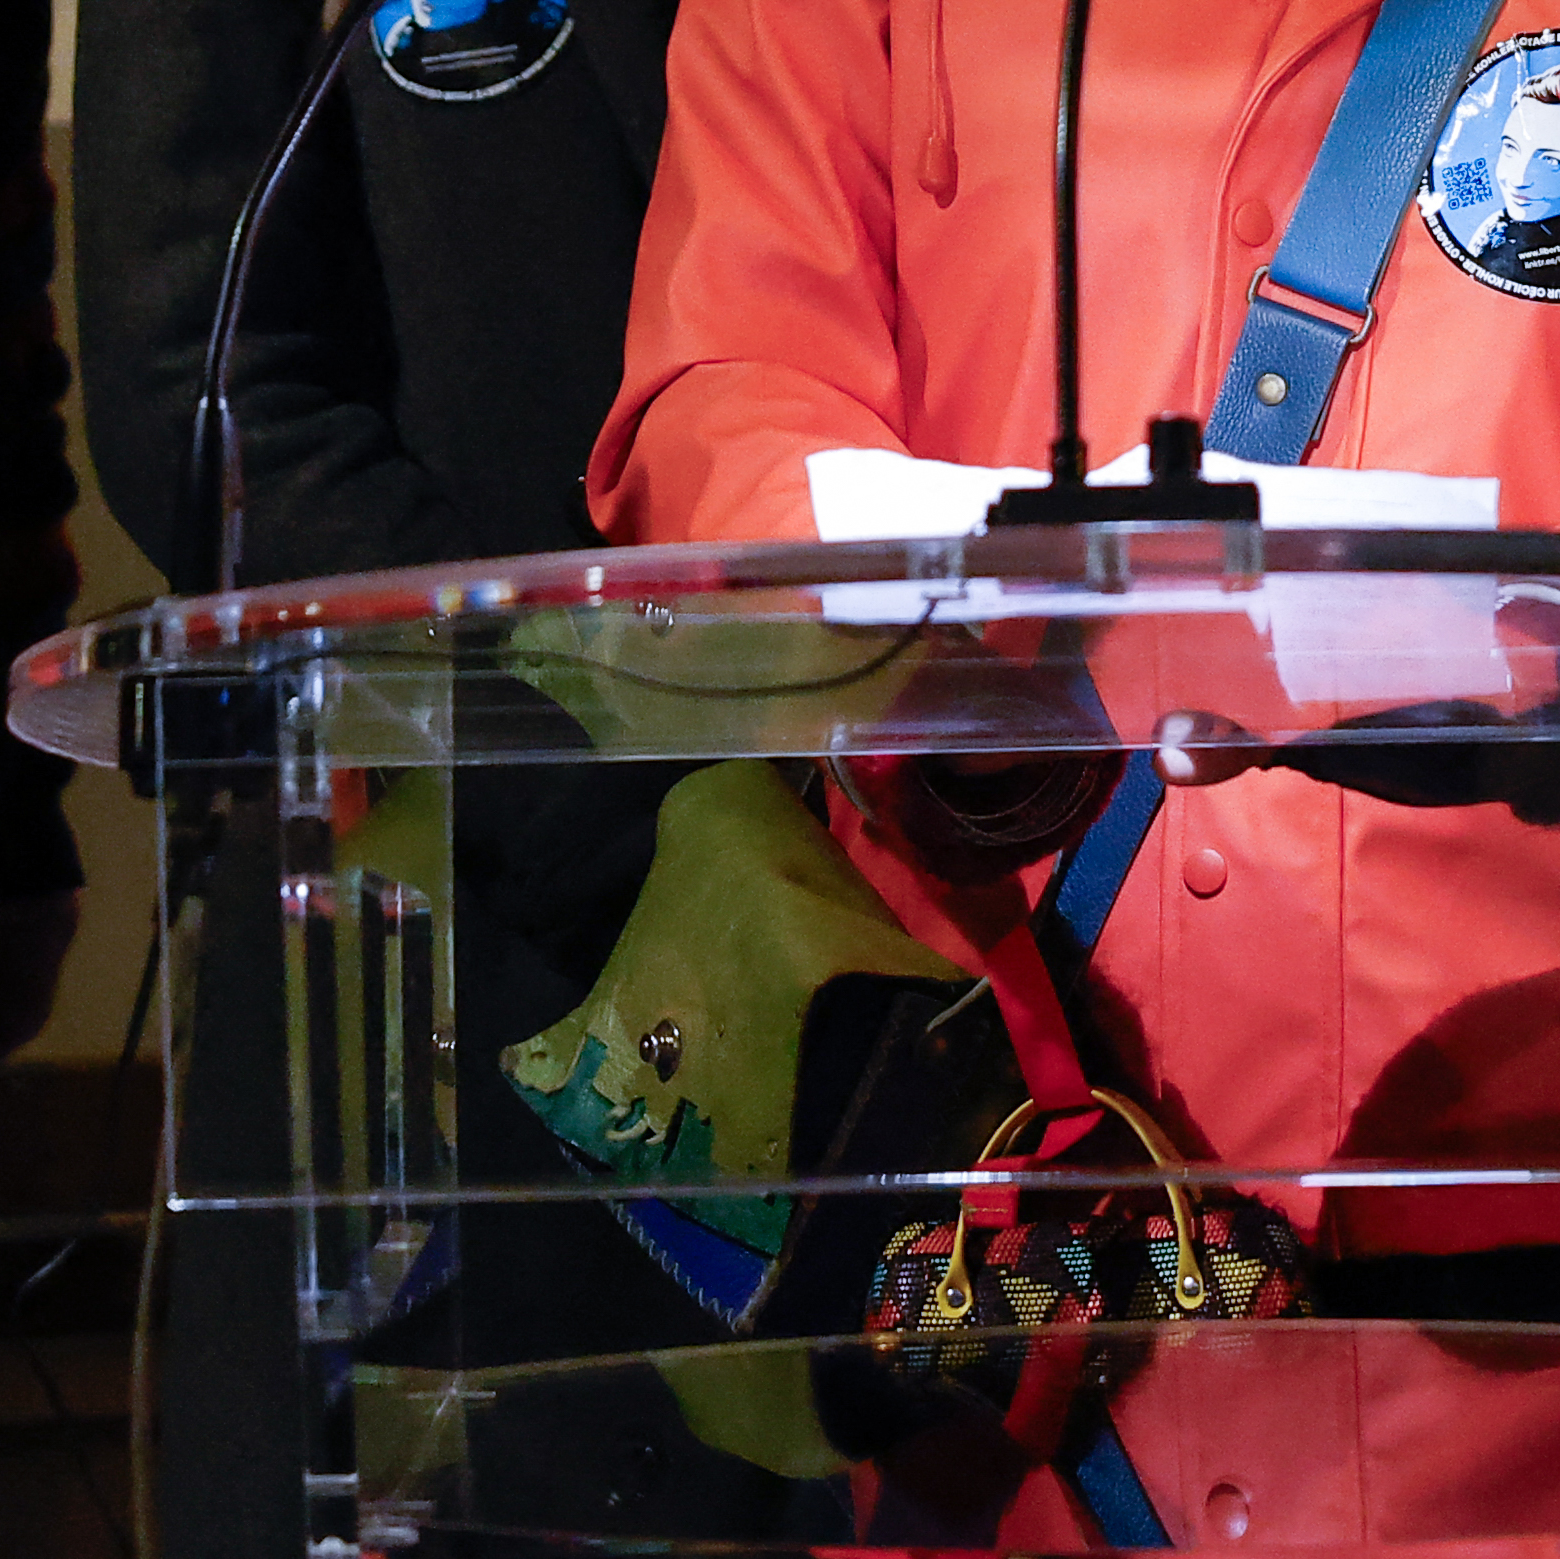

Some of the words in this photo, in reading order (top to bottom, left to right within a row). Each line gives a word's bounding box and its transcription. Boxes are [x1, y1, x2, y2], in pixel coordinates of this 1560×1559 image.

[1432, 224, 1460, 259] OTAGE
[1462, 258, 1505, 288] KOHLER
[1504, 279, 1546, 299] CÉCILE
